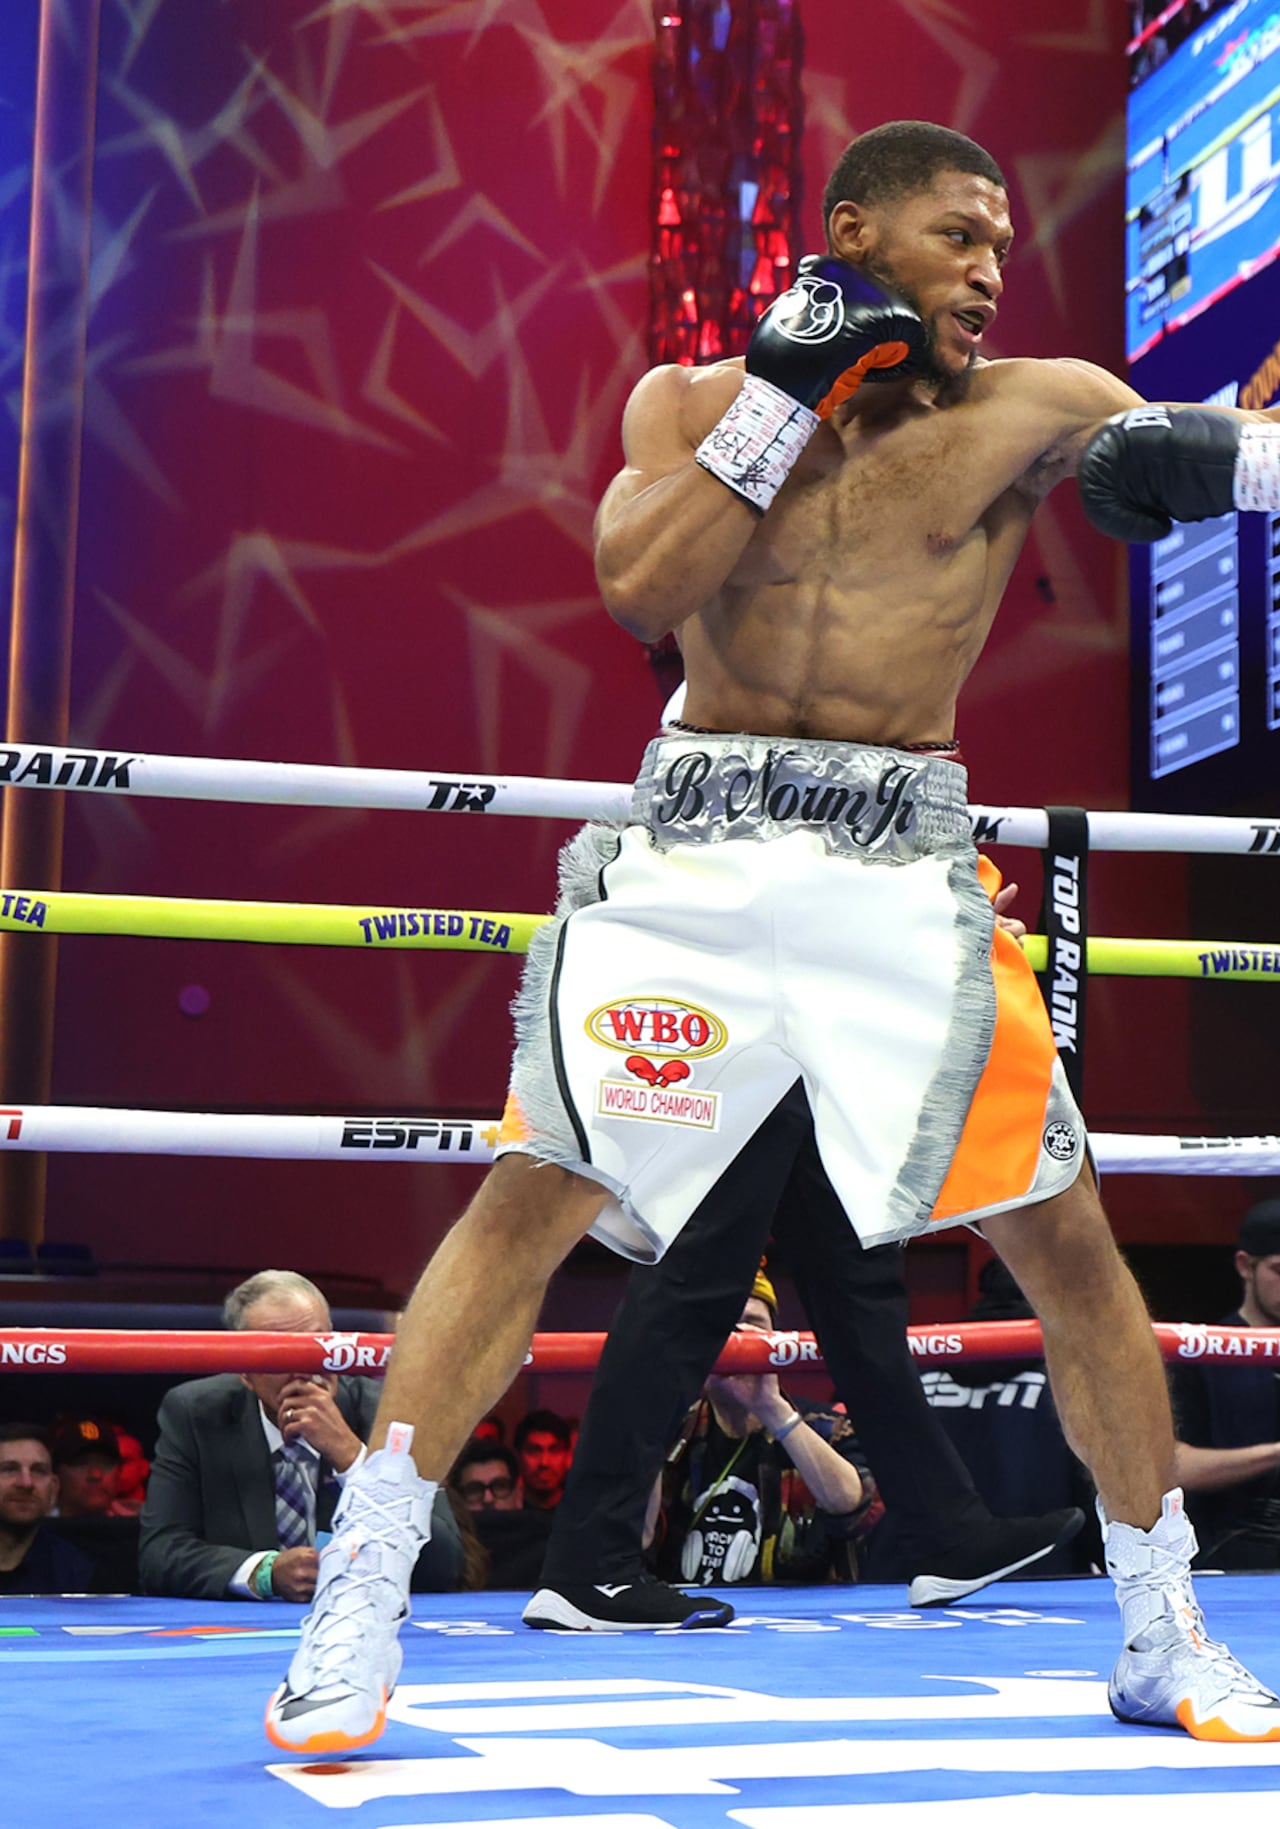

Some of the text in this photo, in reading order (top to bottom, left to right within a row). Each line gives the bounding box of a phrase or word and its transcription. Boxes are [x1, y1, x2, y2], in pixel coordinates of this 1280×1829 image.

[0, 751, 136, 788] RANK
[657, 751, 711, 824] B
[1, 894, 47, 928] TEA
[1053, 854, 1081, 936] TOP
[358, 913, 511, 949] TWISTED TEA
[1051, 941, 1081, 1053] RANK
[606, 1009, 710, 1047] WBO
[604, 1086, 713, 1121] WORLD CHAMPION
[708, 1542, 726, 1557] TO
